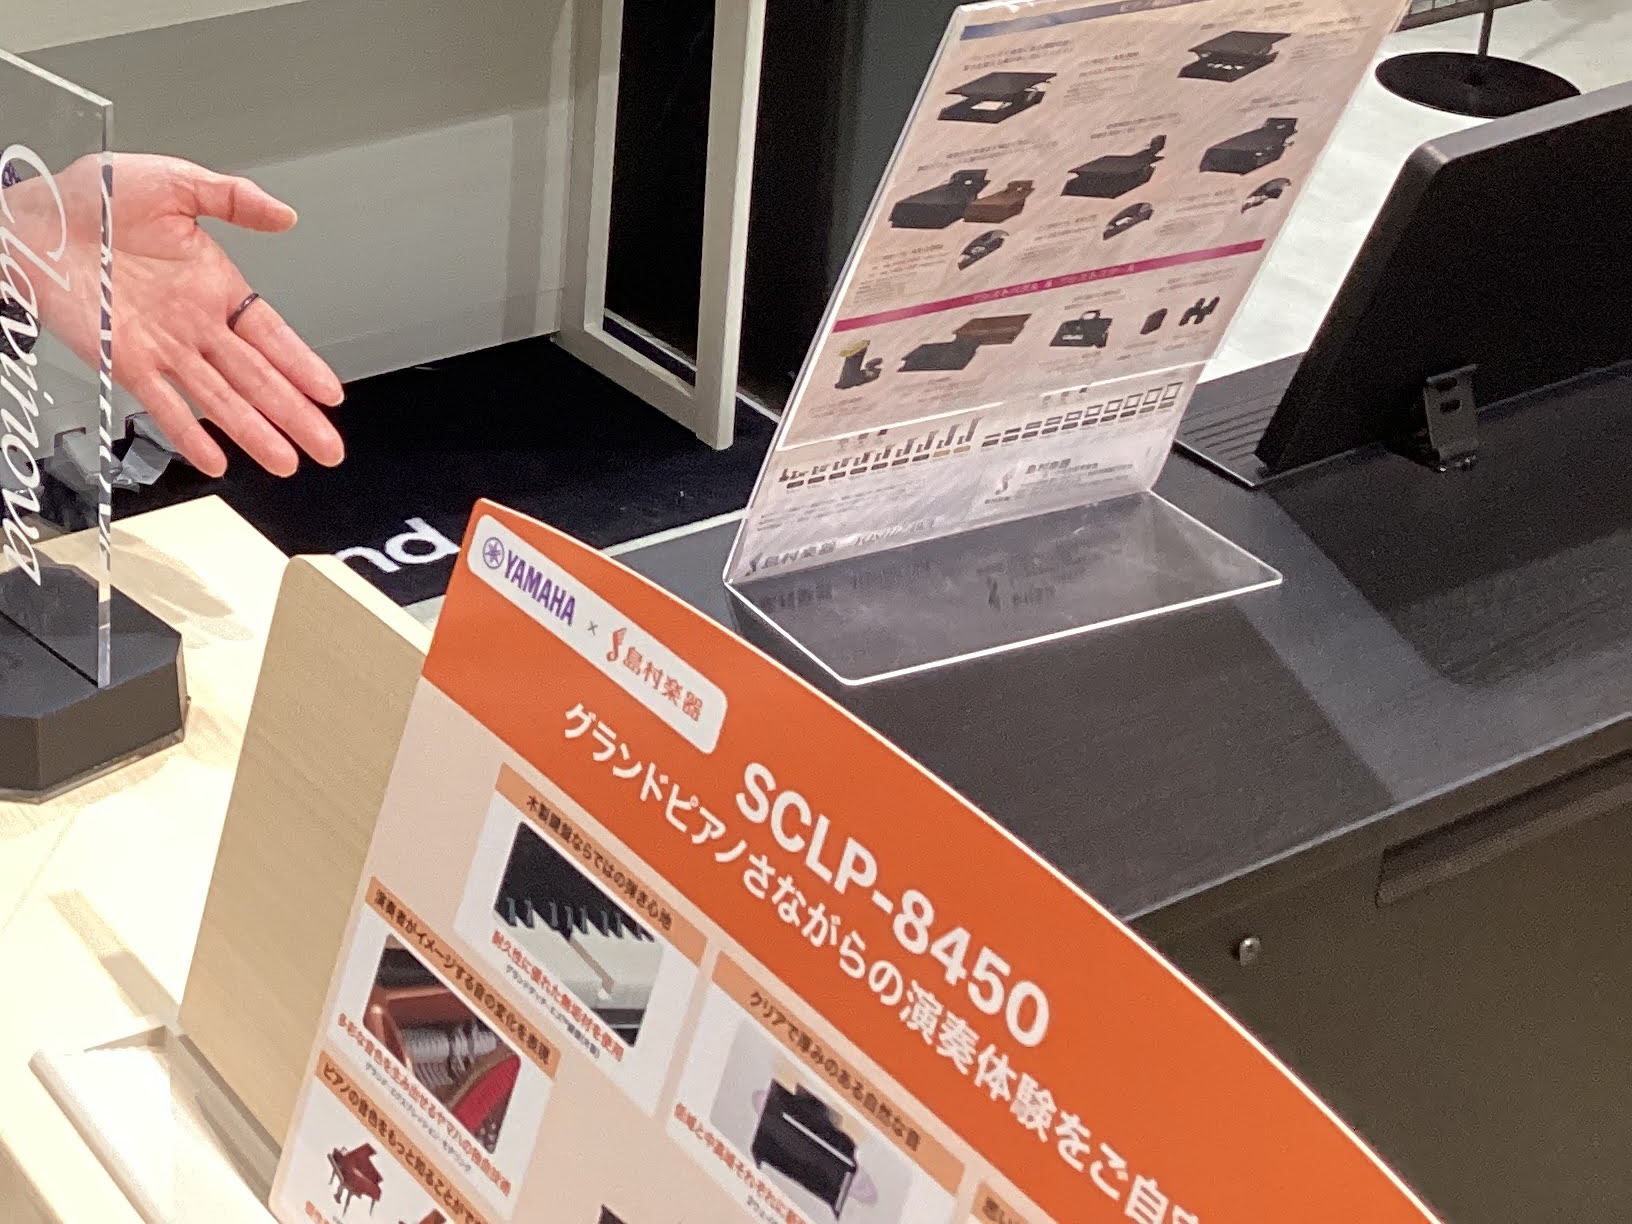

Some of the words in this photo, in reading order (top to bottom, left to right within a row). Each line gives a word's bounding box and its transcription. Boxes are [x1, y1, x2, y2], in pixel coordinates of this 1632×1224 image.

[504, 549, 576, 626] YAMAHA
[623, 646, 704, 723] 島村楽器
[525, 794, 674, 931] 木製鍵盤ならではの弾き心地
[734, 761, 1052, 1049] SCLP-8450
[749, 990, 922, 1153] クリアで厚みのある自然な音
